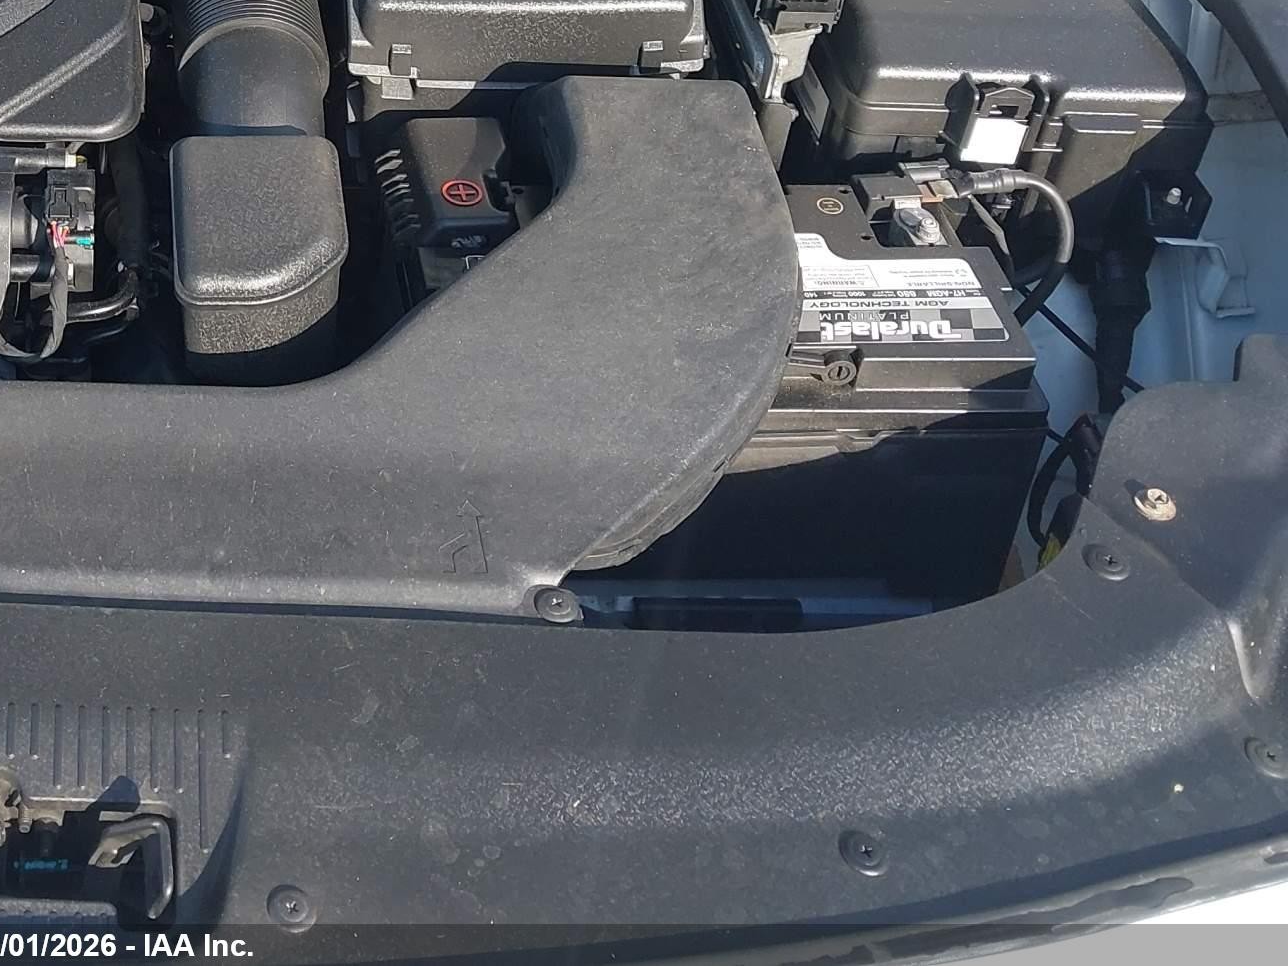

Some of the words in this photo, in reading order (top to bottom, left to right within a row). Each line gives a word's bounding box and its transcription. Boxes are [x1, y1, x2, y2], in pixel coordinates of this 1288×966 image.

[809, 300, 910, 308] TECHNOLOGY
[915, 300, 949, 308] AGM
[819, 311, 909, 321] PLATINUM
[820, 320, 961, 341] Duralast
